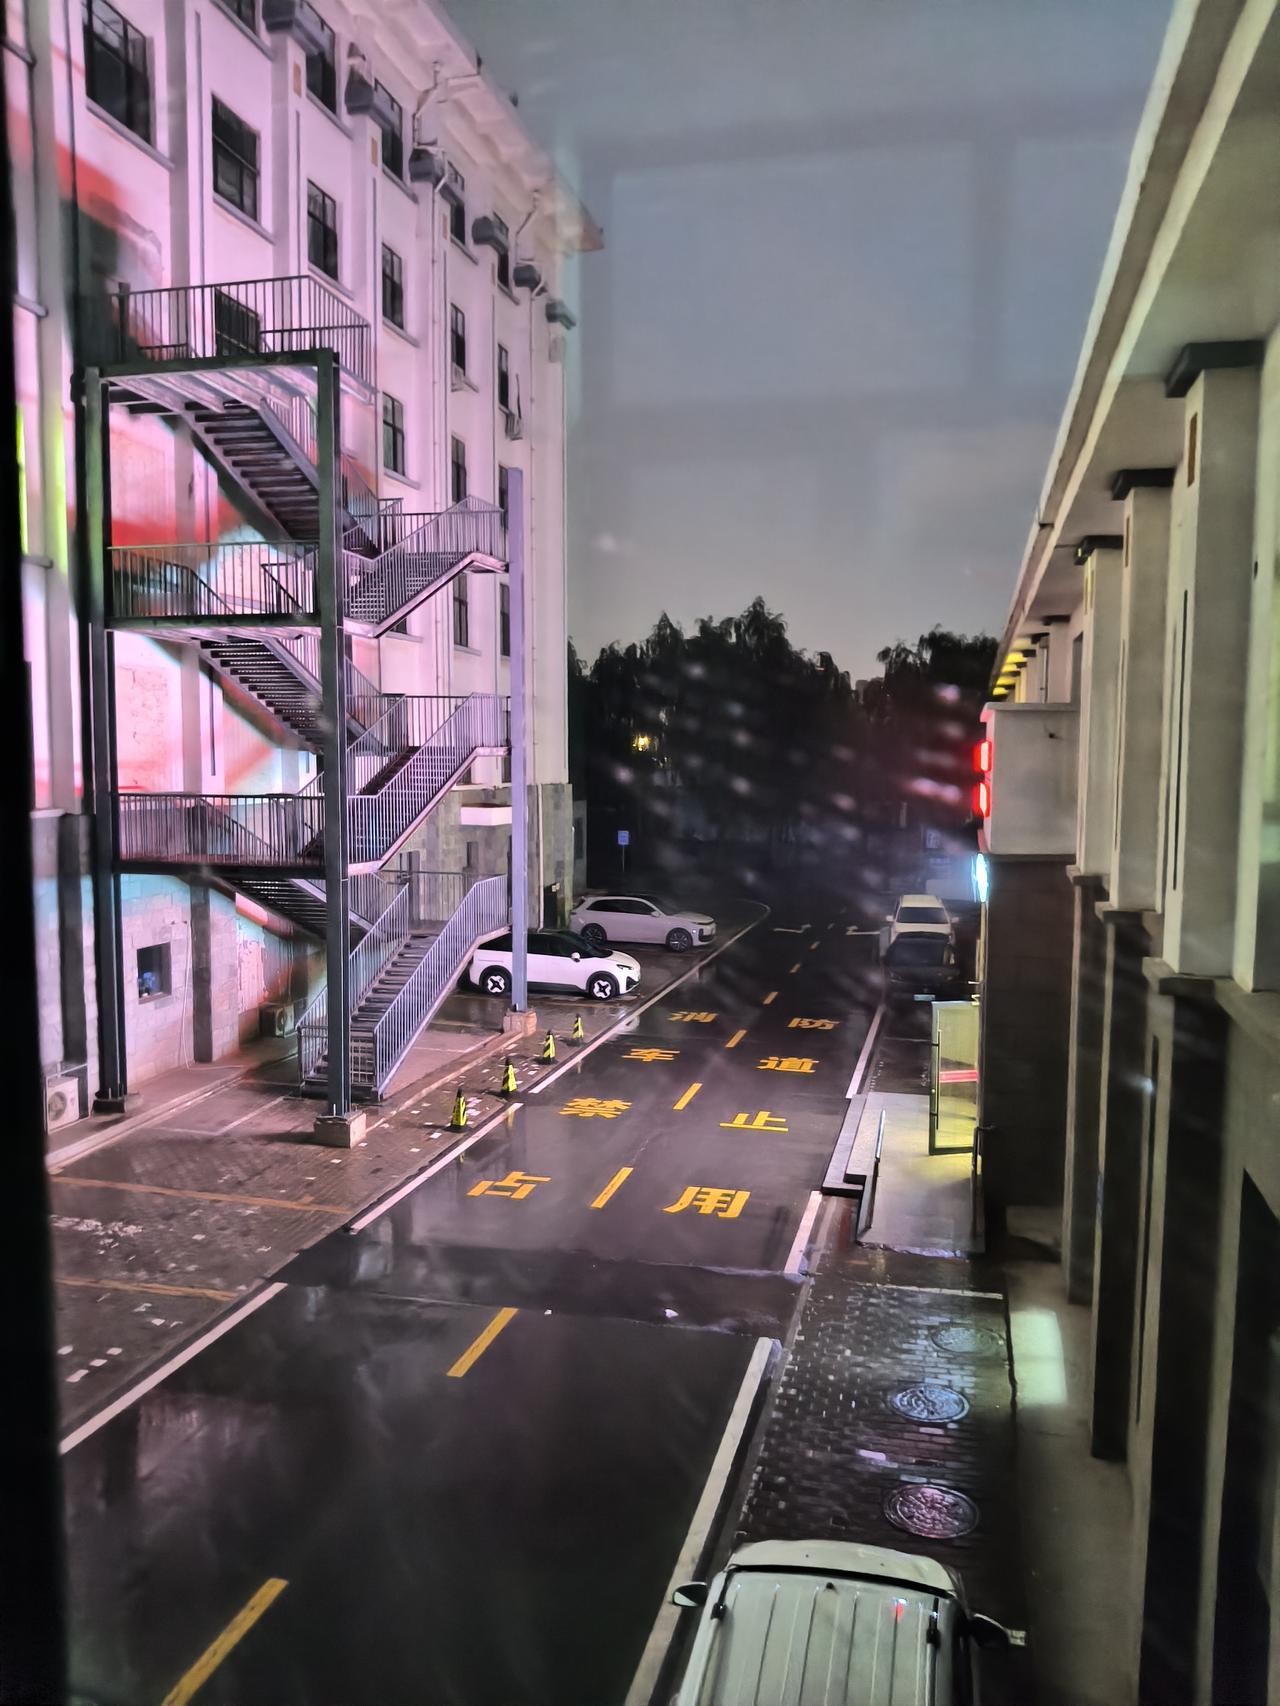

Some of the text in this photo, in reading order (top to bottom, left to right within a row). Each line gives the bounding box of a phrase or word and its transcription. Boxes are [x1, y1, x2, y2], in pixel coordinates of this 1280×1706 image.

[668, 1011, 841, 1030] 消防
[622, 1048, 820, 1073] 车道
[558, 1097, 789, 1132] 禁止
[466, 1171, 751, 1218] 占用
